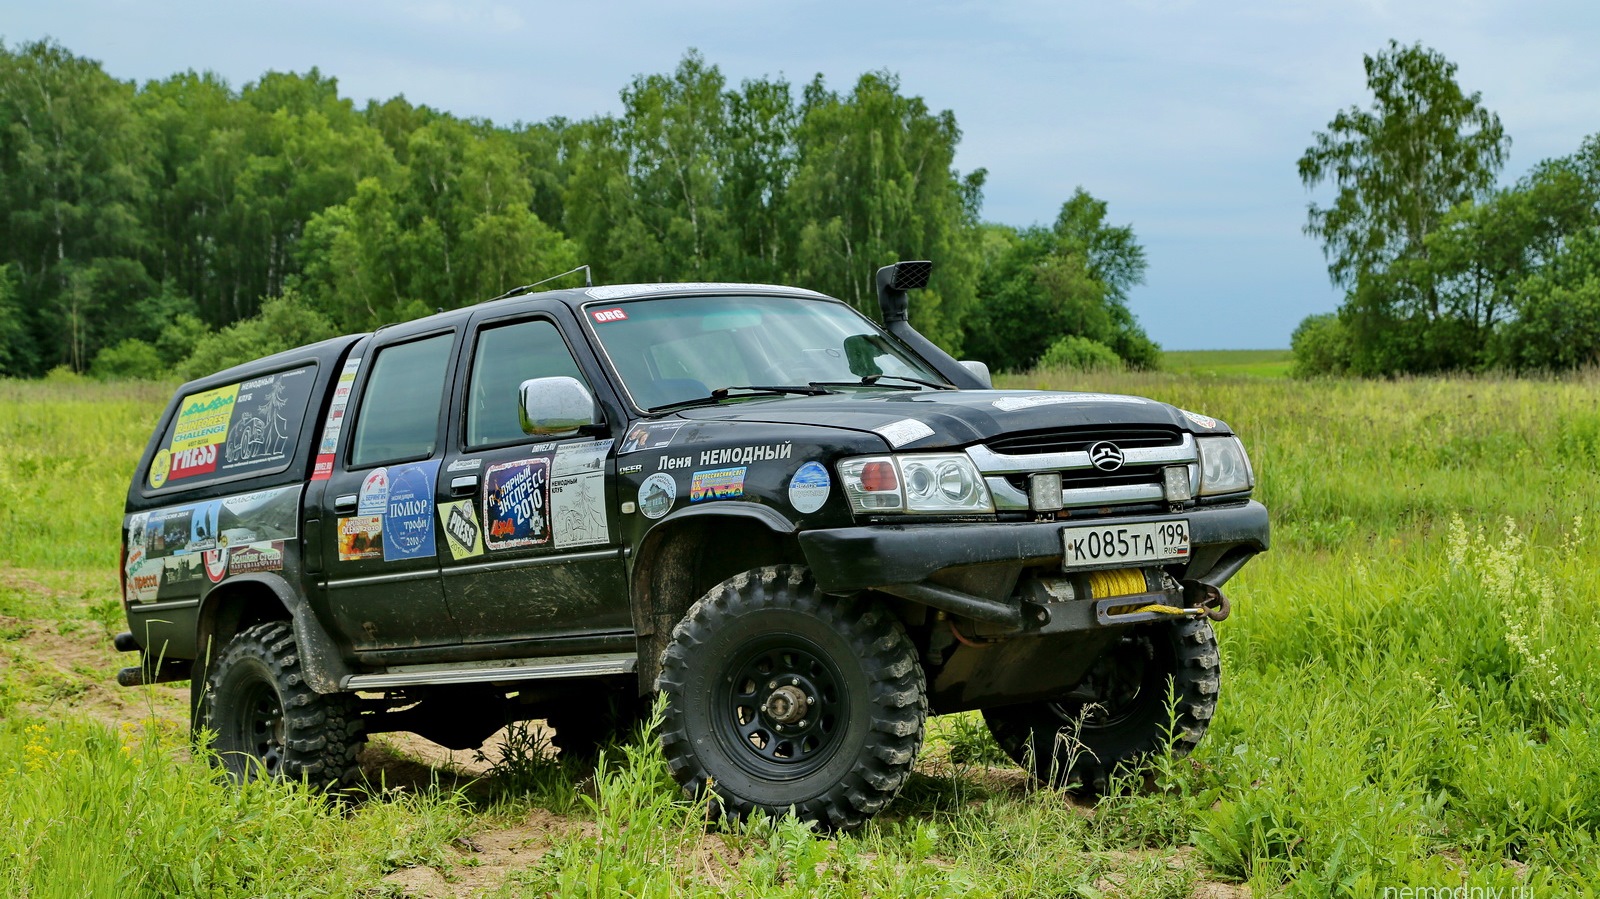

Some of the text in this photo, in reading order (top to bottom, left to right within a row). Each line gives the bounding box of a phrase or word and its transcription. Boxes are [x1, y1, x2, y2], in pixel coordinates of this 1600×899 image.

[594, 309, 626, 322] ORG
[237, 393, 253, 403] КЛУБ
[174, 424, 226, 442] CHALLENGE
[173, 444, 217, 471] PRESS
[658, 440, 793, 471] Леня НЕМОДНЫЙ
[619, 464, 643, 473] DEER
[552, 477, 578, 487] НЕМОДНЫЙ
[552, 486, 563, 494] КЛУБ
[499, 468, 545, 517] ЭКСПРЕСС
[389, 499, 428, 518] ПОМОР
[514, 488, 543, 526] 2010
[449, 510, 475, 547] PRESS
[450, 541, 465, 557] 2010
[1073, 523, 1184, 561] К085ТА 199
[1163, 546, 1178, 555] RUS
